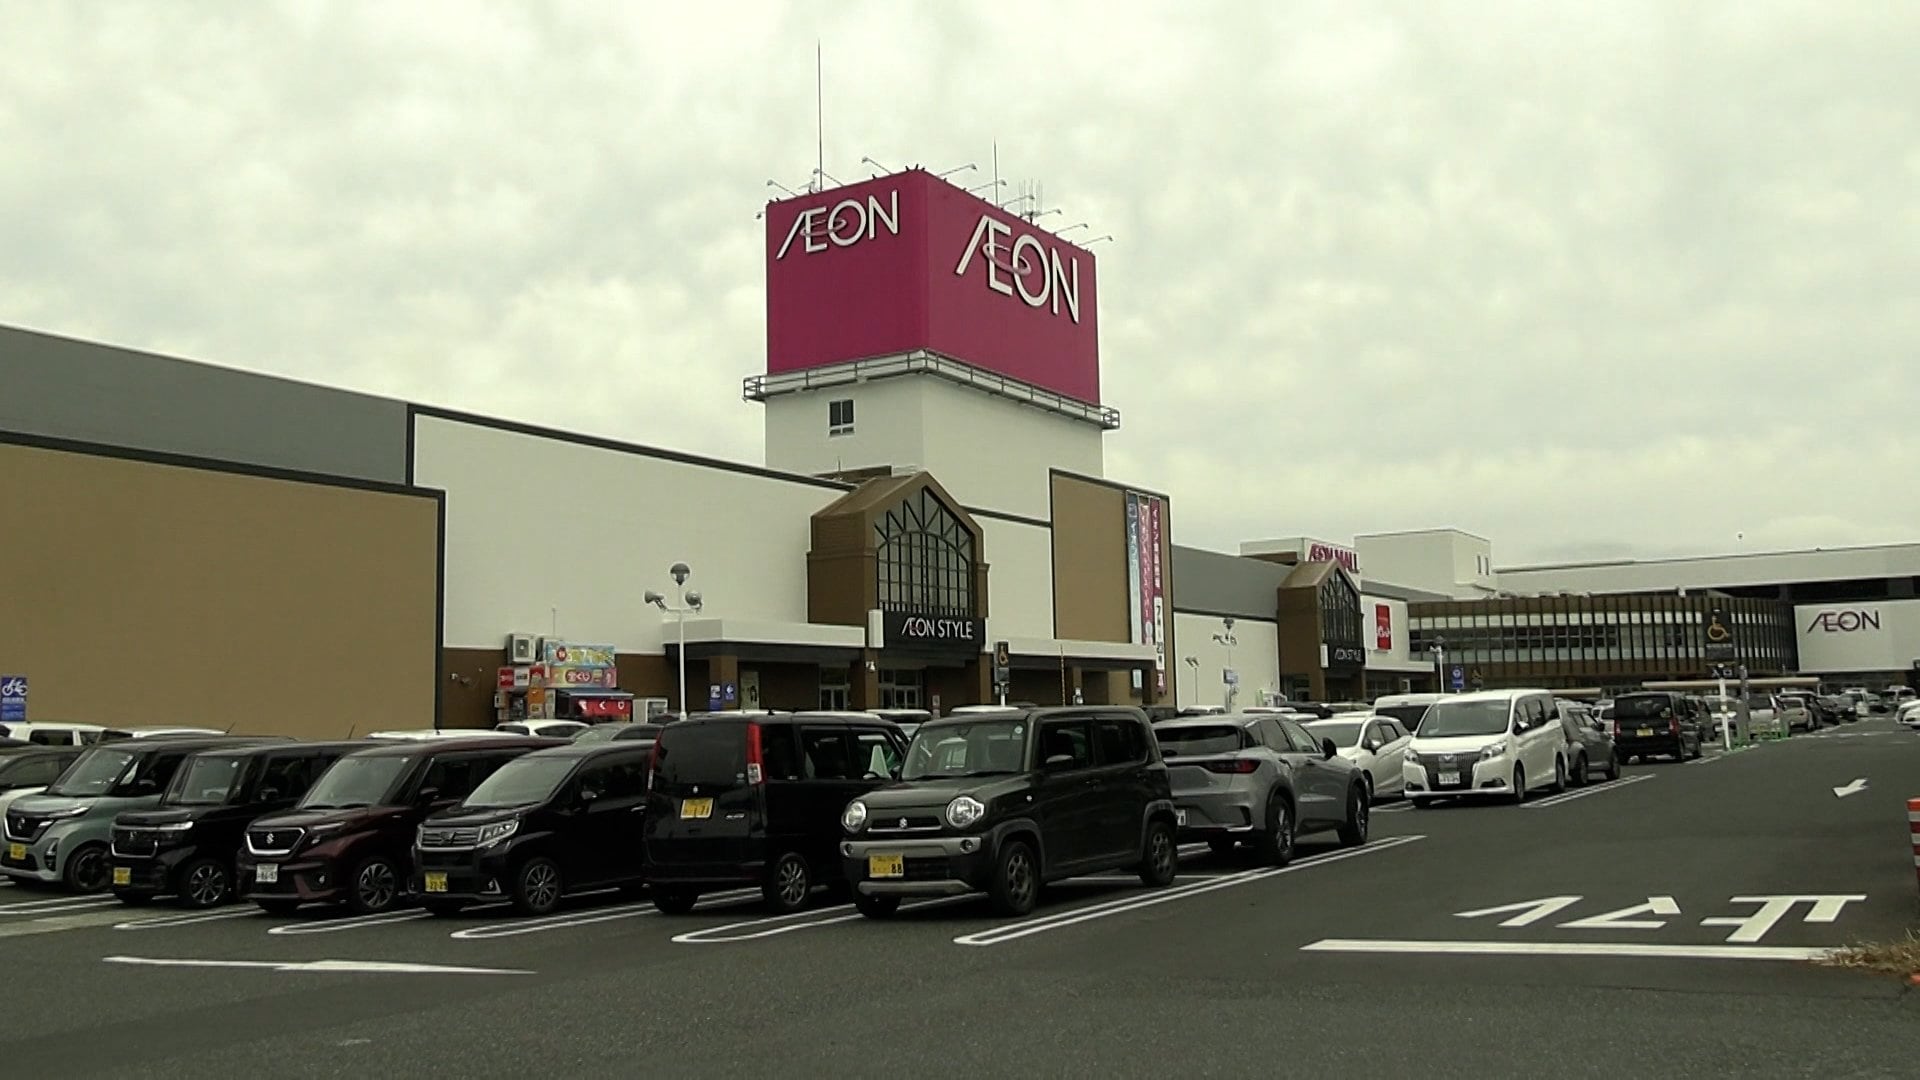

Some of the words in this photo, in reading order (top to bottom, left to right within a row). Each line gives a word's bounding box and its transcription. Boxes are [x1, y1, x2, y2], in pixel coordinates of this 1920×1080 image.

[937, 619, 973, 639] STYLE
[1453, 895, 1867, 942] 止マレ
